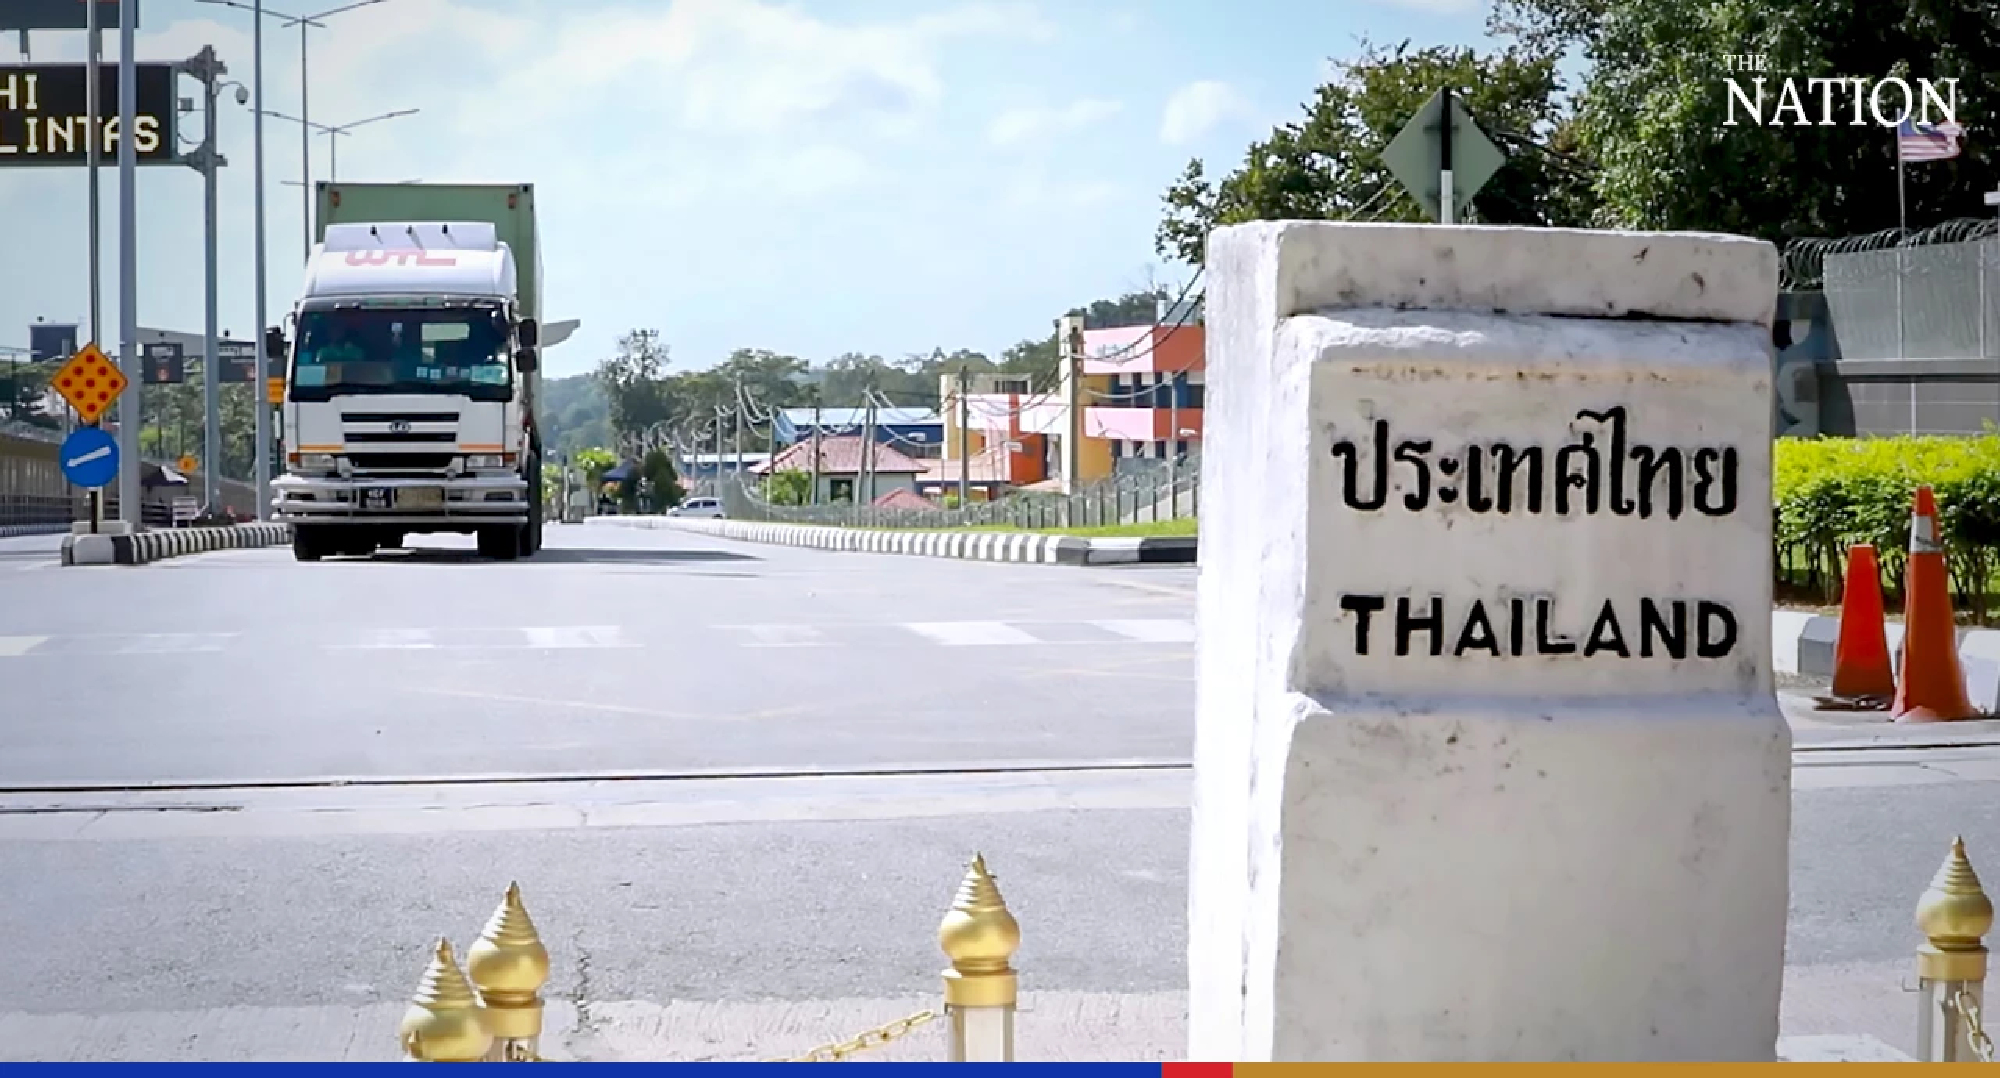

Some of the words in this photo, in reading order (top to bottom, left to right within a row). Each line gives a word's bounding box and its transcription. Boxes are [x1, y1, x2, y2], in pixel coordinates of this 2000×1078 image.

[1331, 406, 1739, 519] ประเทศไทย
[1340, 594, 1738, 659] THAILAND
